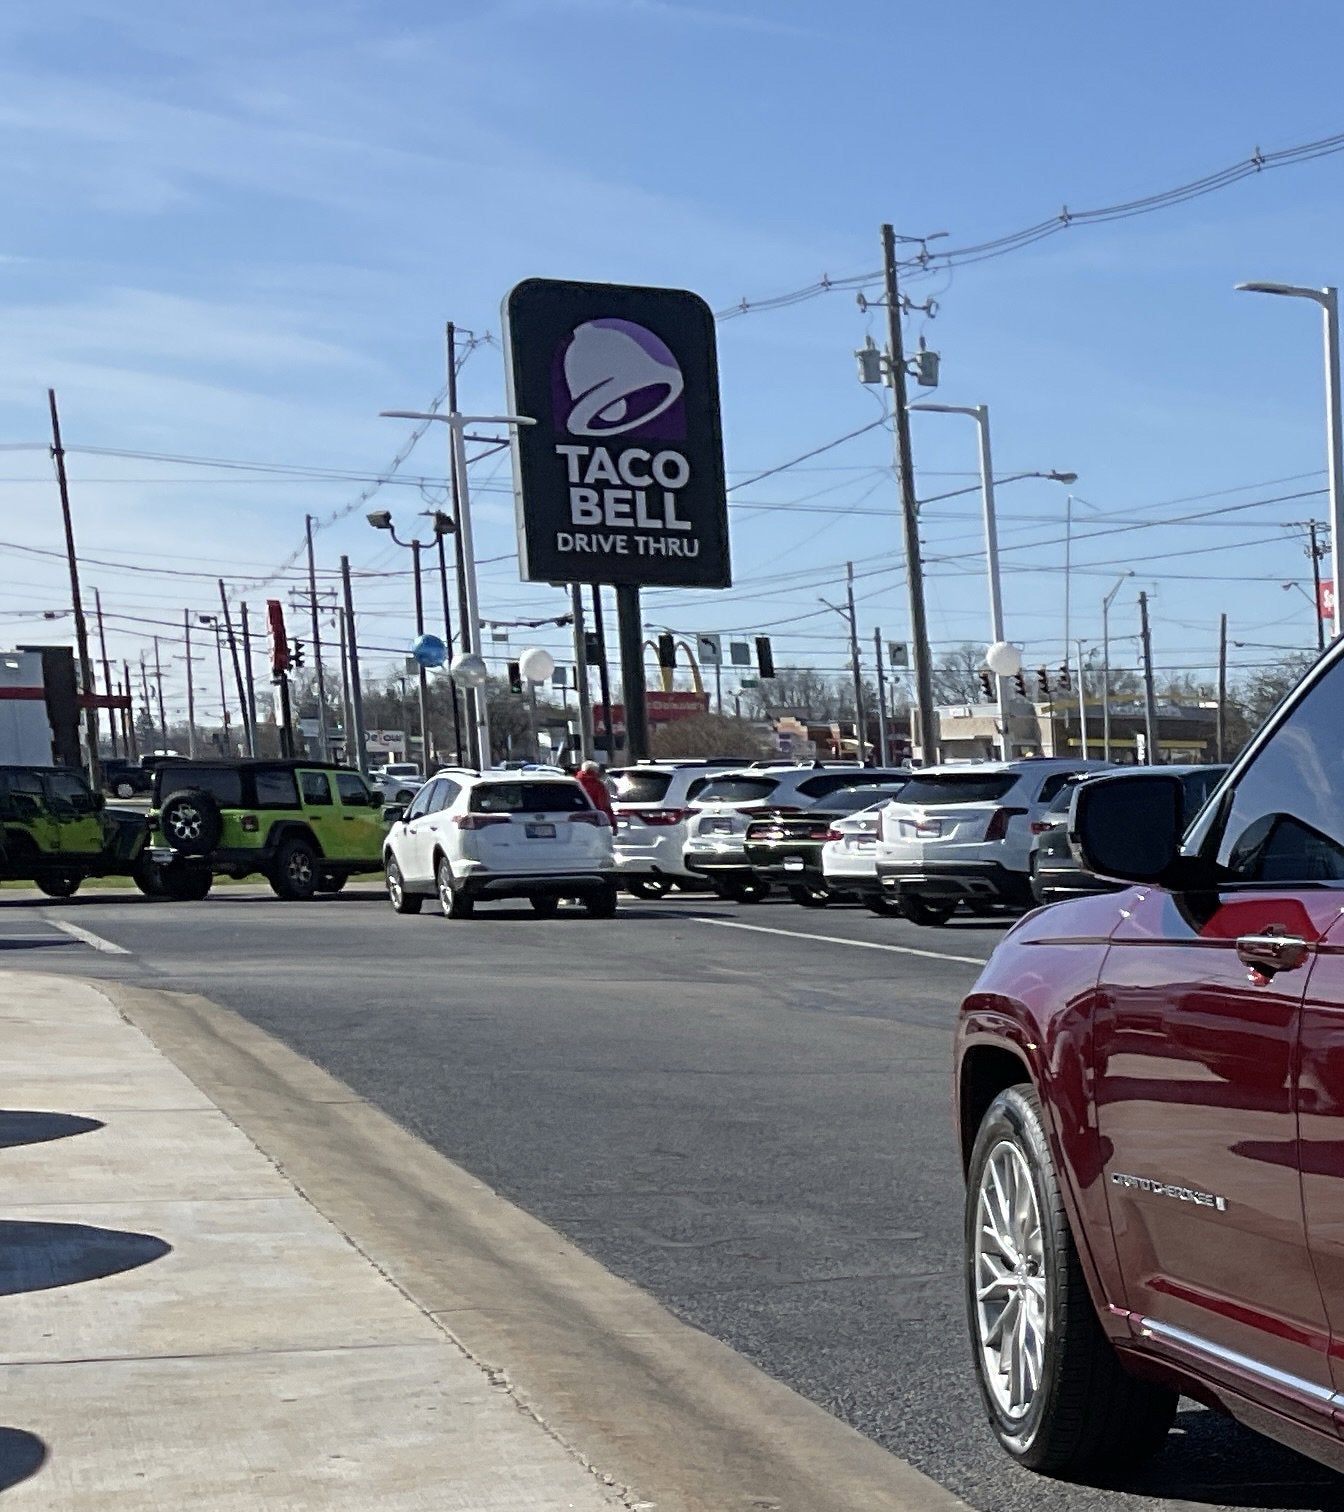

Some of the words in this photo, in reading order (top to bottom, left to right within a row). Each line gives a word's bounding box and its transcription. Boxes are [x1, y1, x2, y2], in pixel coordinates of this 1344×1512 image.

[555, 445, 691, 489] TACO
[569, 487, 692, 531] BELL
[556, 532, 630, 555] DRIVE
[634, 535, 700, 558] THRU
